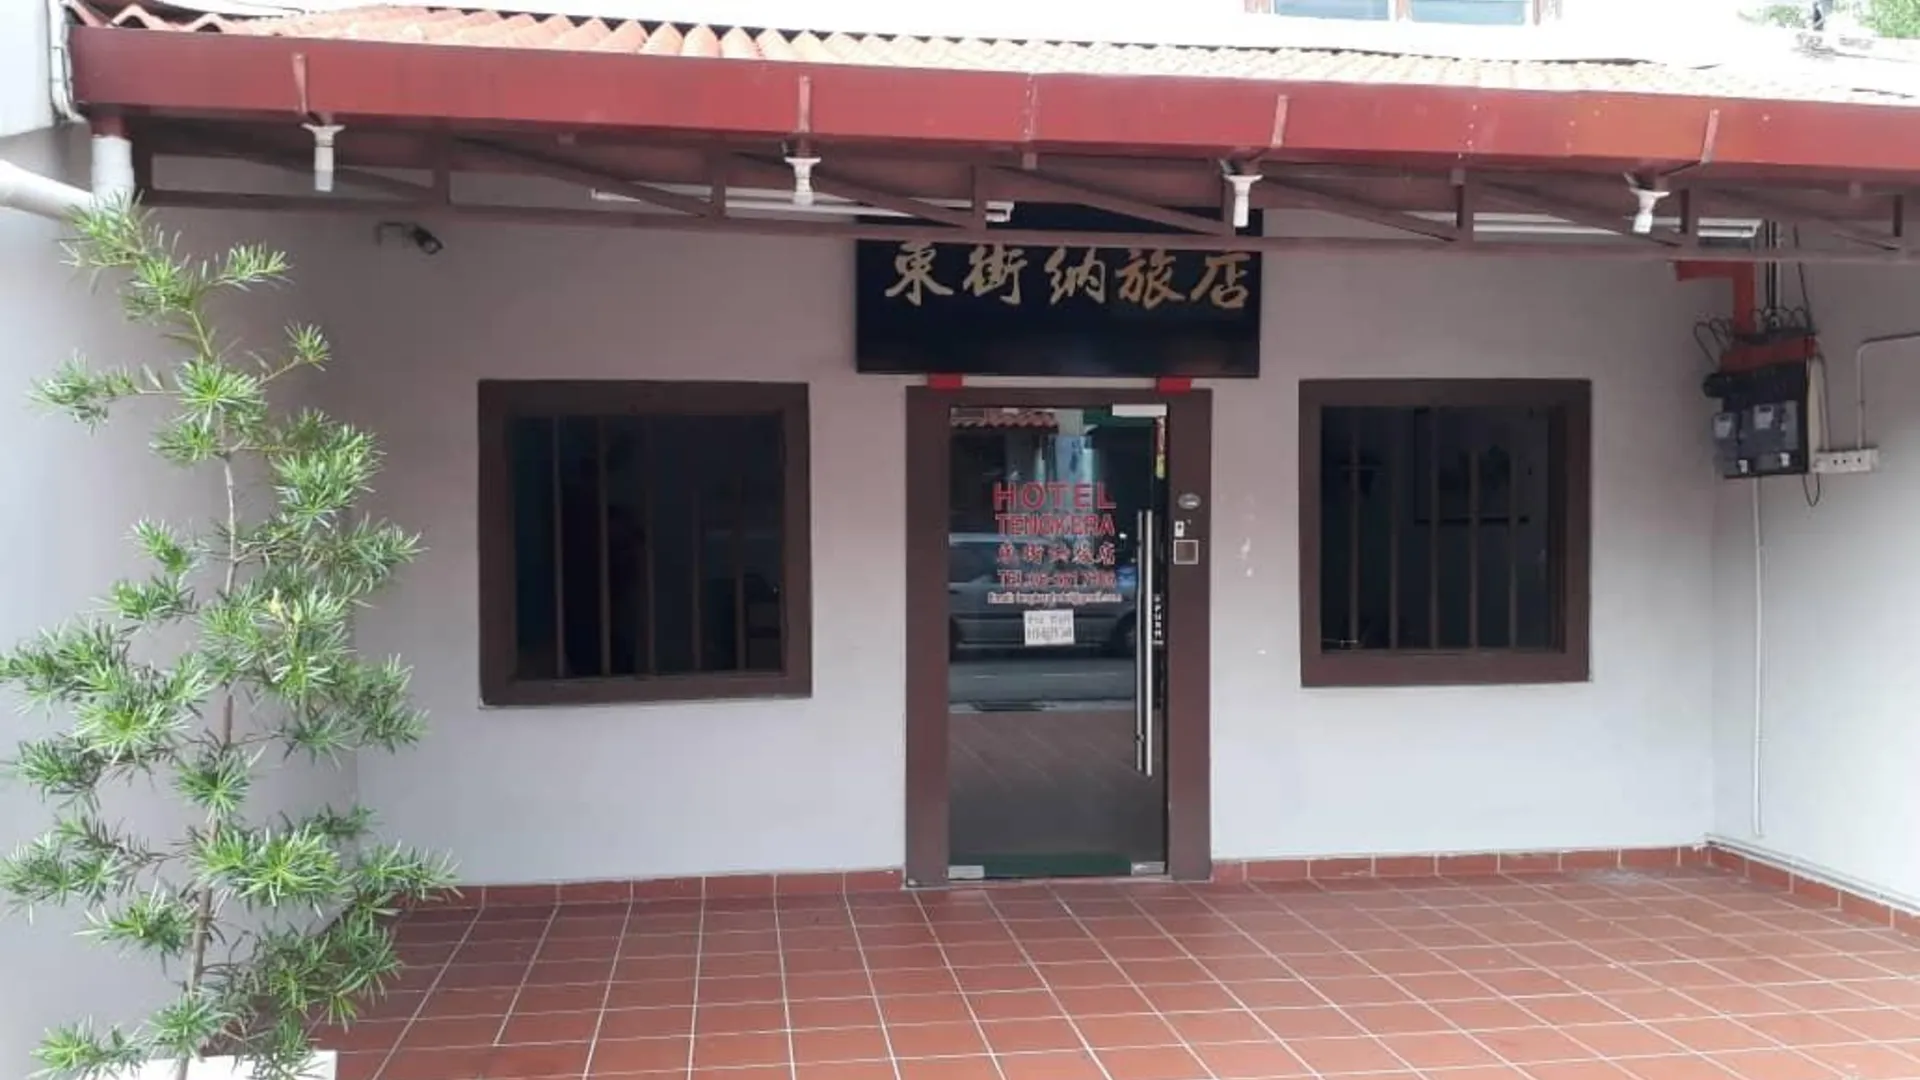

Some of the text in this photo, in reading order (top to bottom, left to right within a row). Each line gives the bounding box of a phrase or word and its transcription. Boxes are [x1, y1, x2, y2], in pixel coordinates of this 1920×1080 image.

[885, 243, 1251, 310] 東街納旅店
[992, 481, 1117, 510] HOTEL
